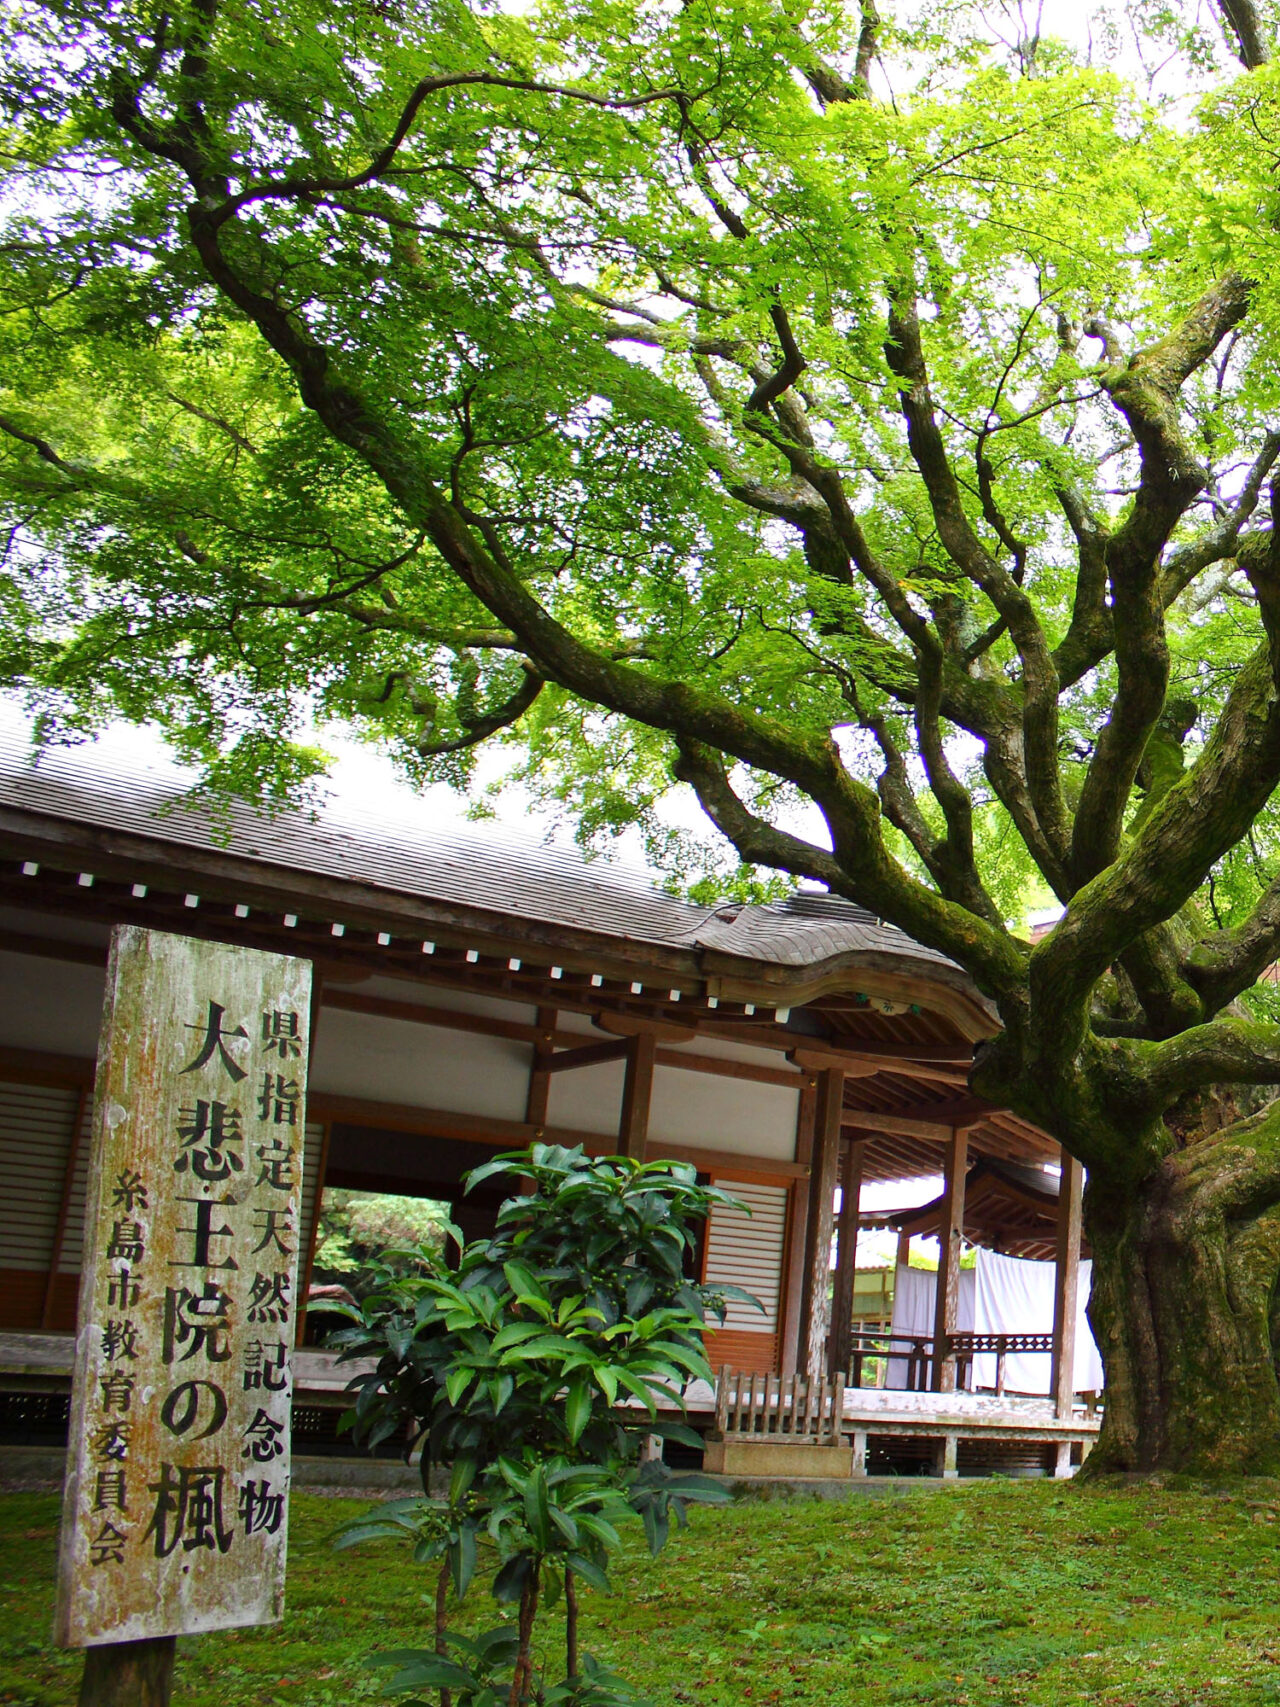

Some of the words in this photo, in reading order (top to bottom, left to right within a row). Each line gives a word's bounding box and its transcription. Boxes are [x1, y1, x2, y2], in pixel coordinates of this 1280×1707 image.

[90, 1167, 148, 1566] 糸島市教育委員会
[142, 1000, 249, 1558] 大悲王院の楓
[238, 1009, 302, 1535] 県指定天然記念物
